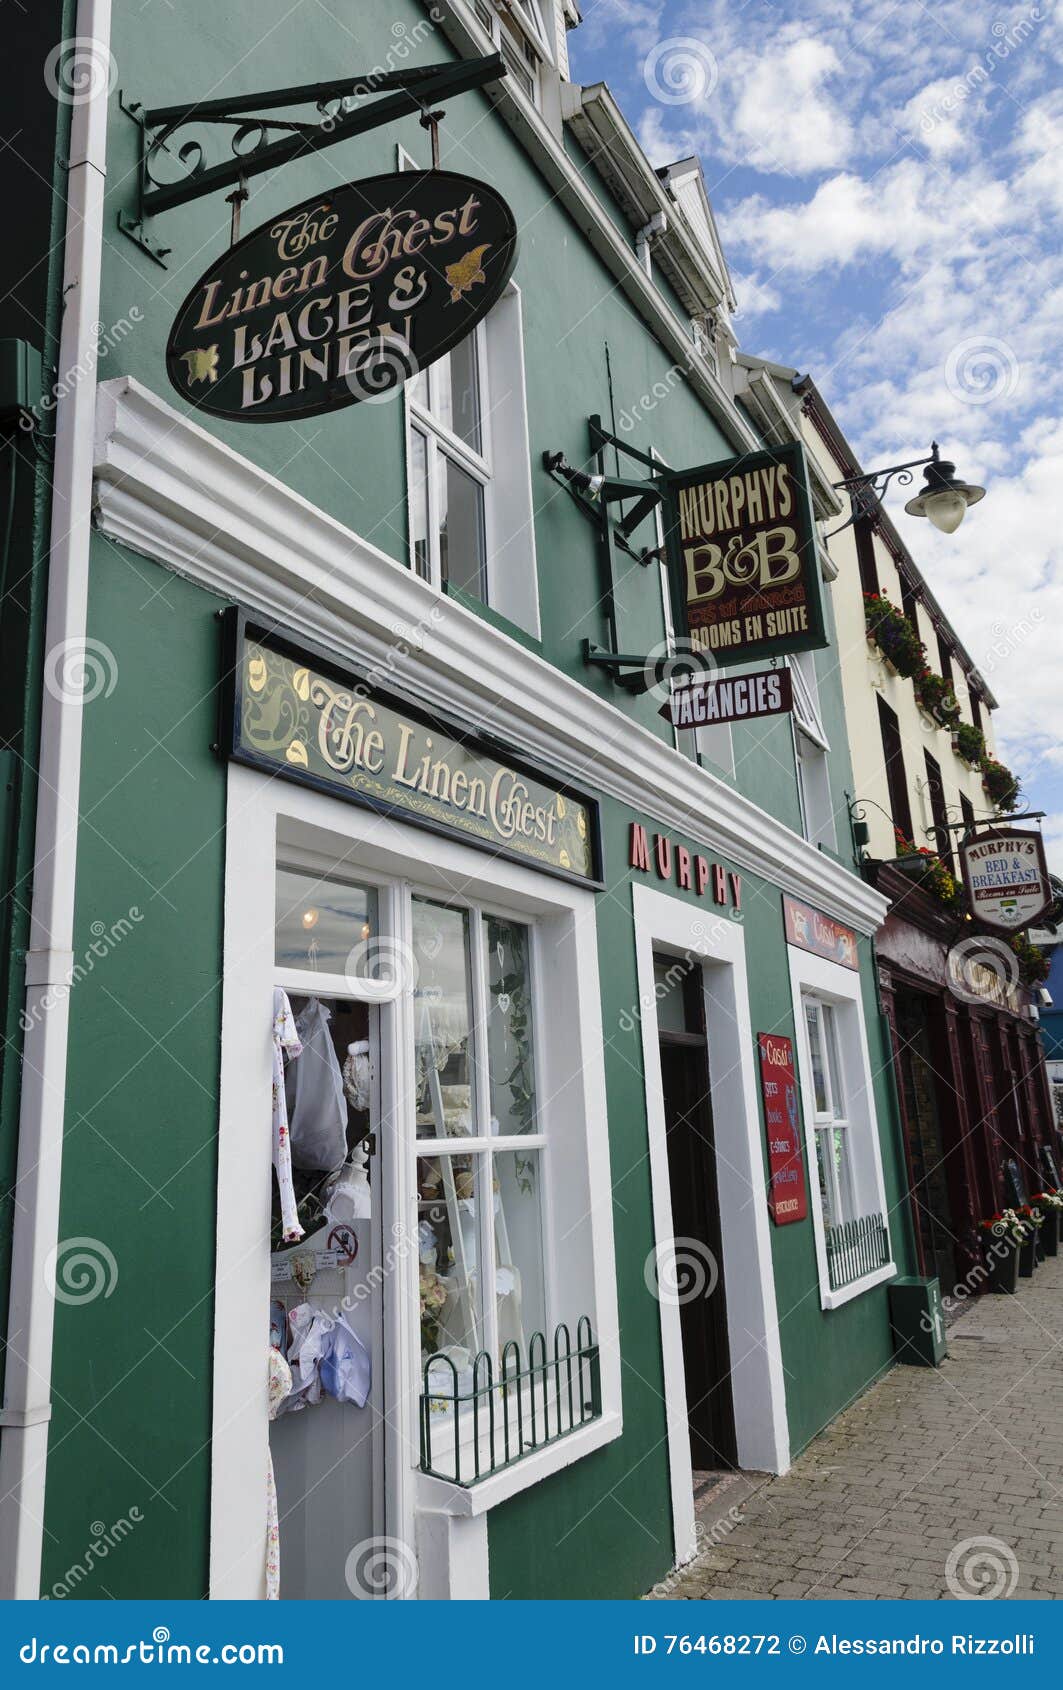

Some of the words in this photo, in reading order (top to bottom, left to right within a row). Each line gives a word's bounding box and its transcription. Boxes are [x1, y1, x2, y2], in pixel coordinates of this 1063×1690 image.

[194, 254, 328, 331] Linen
[342, 193, 480, 281] Chest
[270, 204, 339, 261] The
[233, 282, 374, 369] LACE
[388, 265, 428, 310] &
[240, 316, 413, 409] LINEN
[679, 463, 793, 541] MURPHYS
[684, 526, 801, 605] B&B
[690, 619, 742, 653] ROOMS
[746, 616, 763, 641] EN
[767, 605, 808, 638] SUITE
[670, 674, 782, 726] VACANCIES
[311, 679, 385, 774] The
[392, 723, 487, 820] Linen
[489, 766, 557, 846] Chest
[629, 822, 742, 912] MURPHY
[968, 841, 1035, 861] MURPHY'S
[972, 868, 1039, 888] BREAKFAST
[985, 859, 1008, 873] BED
[1012, 857, 1021, 870] &
